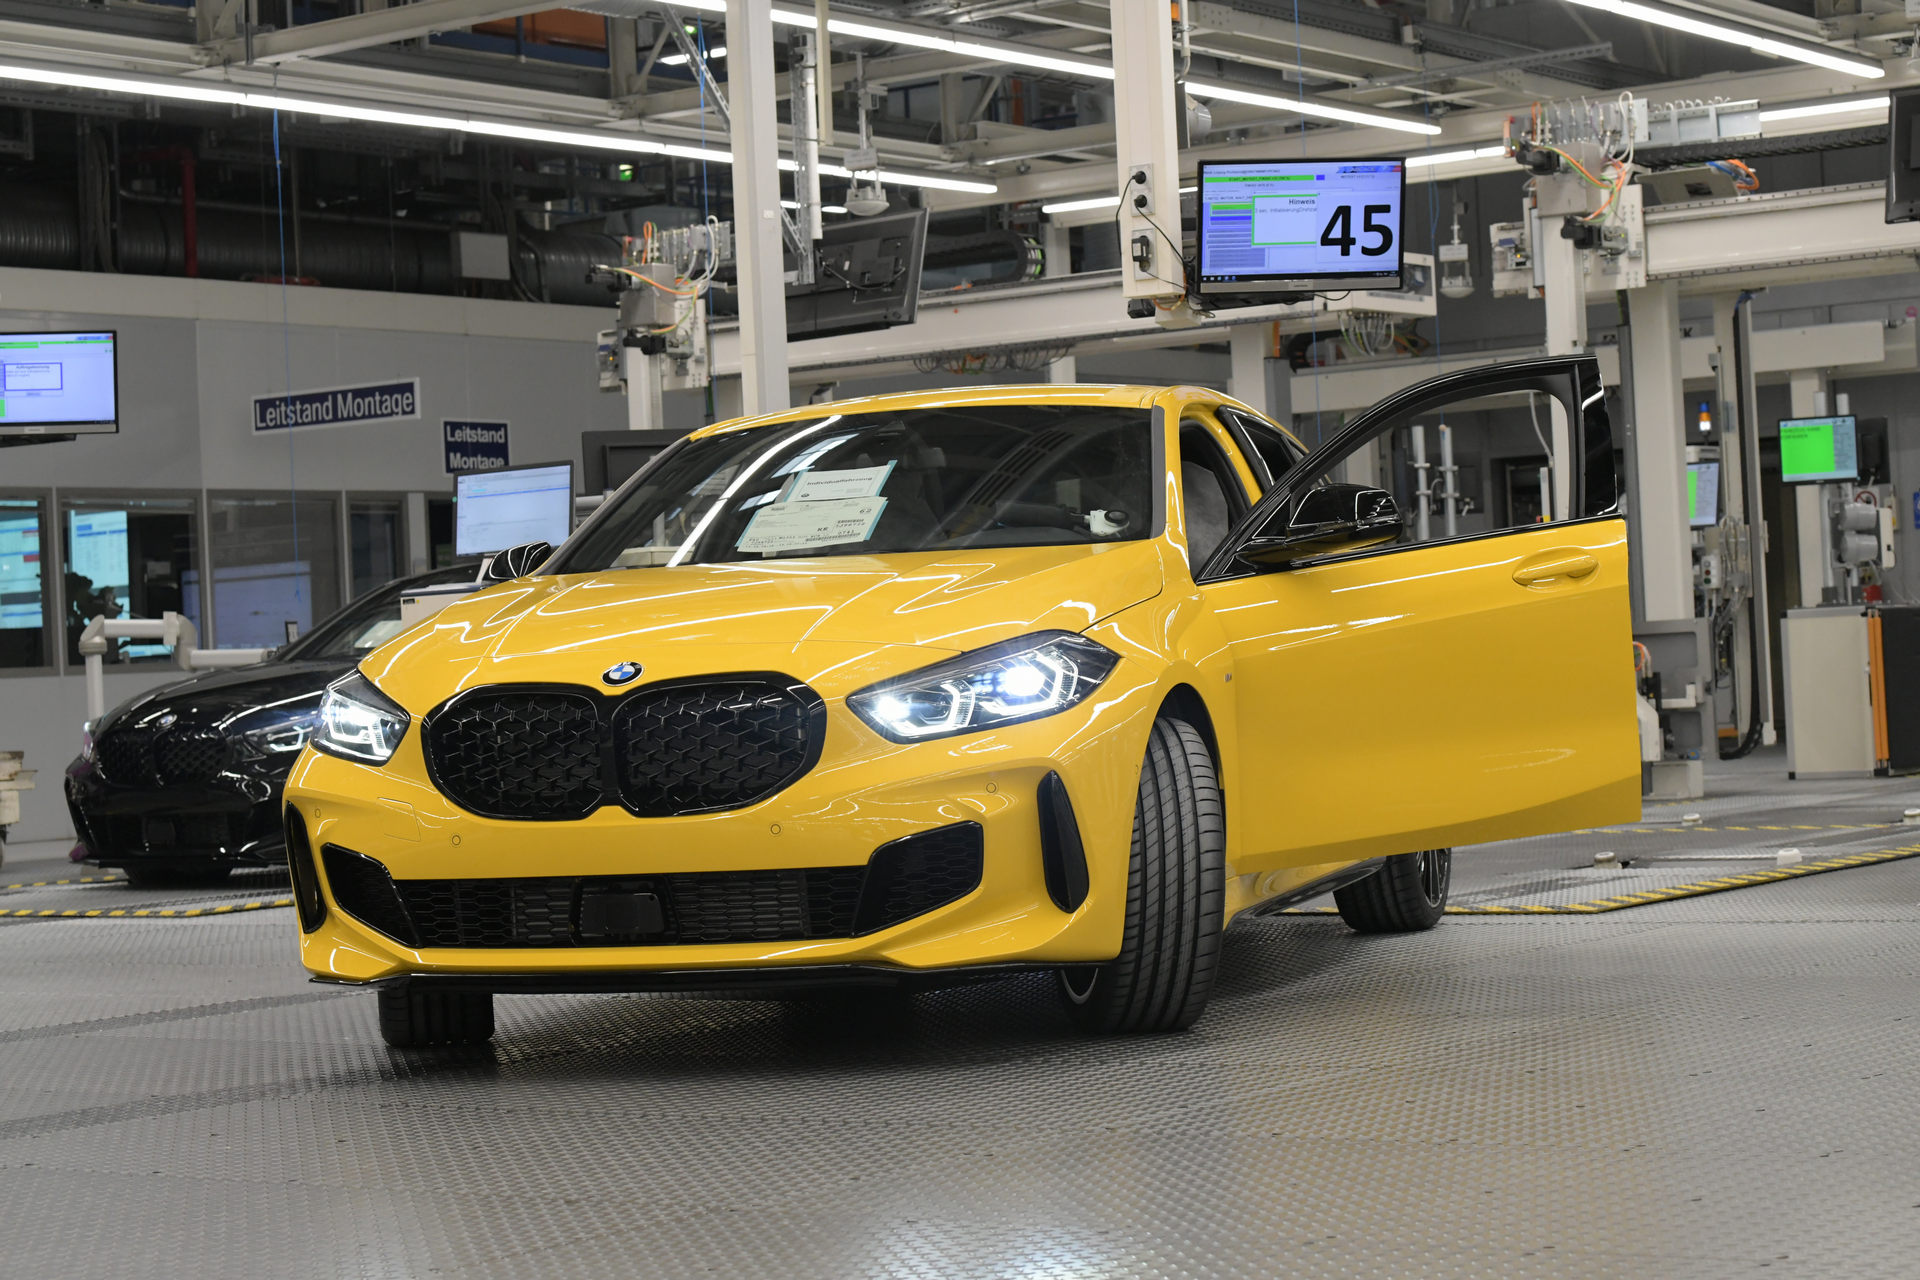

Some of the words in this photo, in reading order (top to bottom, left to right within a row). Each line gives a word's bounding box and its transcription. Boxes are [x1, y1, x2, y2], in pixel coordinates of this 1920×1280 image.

[1320, 204, 1393, 257] 45
[256, 395, 333, 428] Leitstand
[337, 391, 413, 417] Montage
[446, 425, 506, 443] Leitstand
